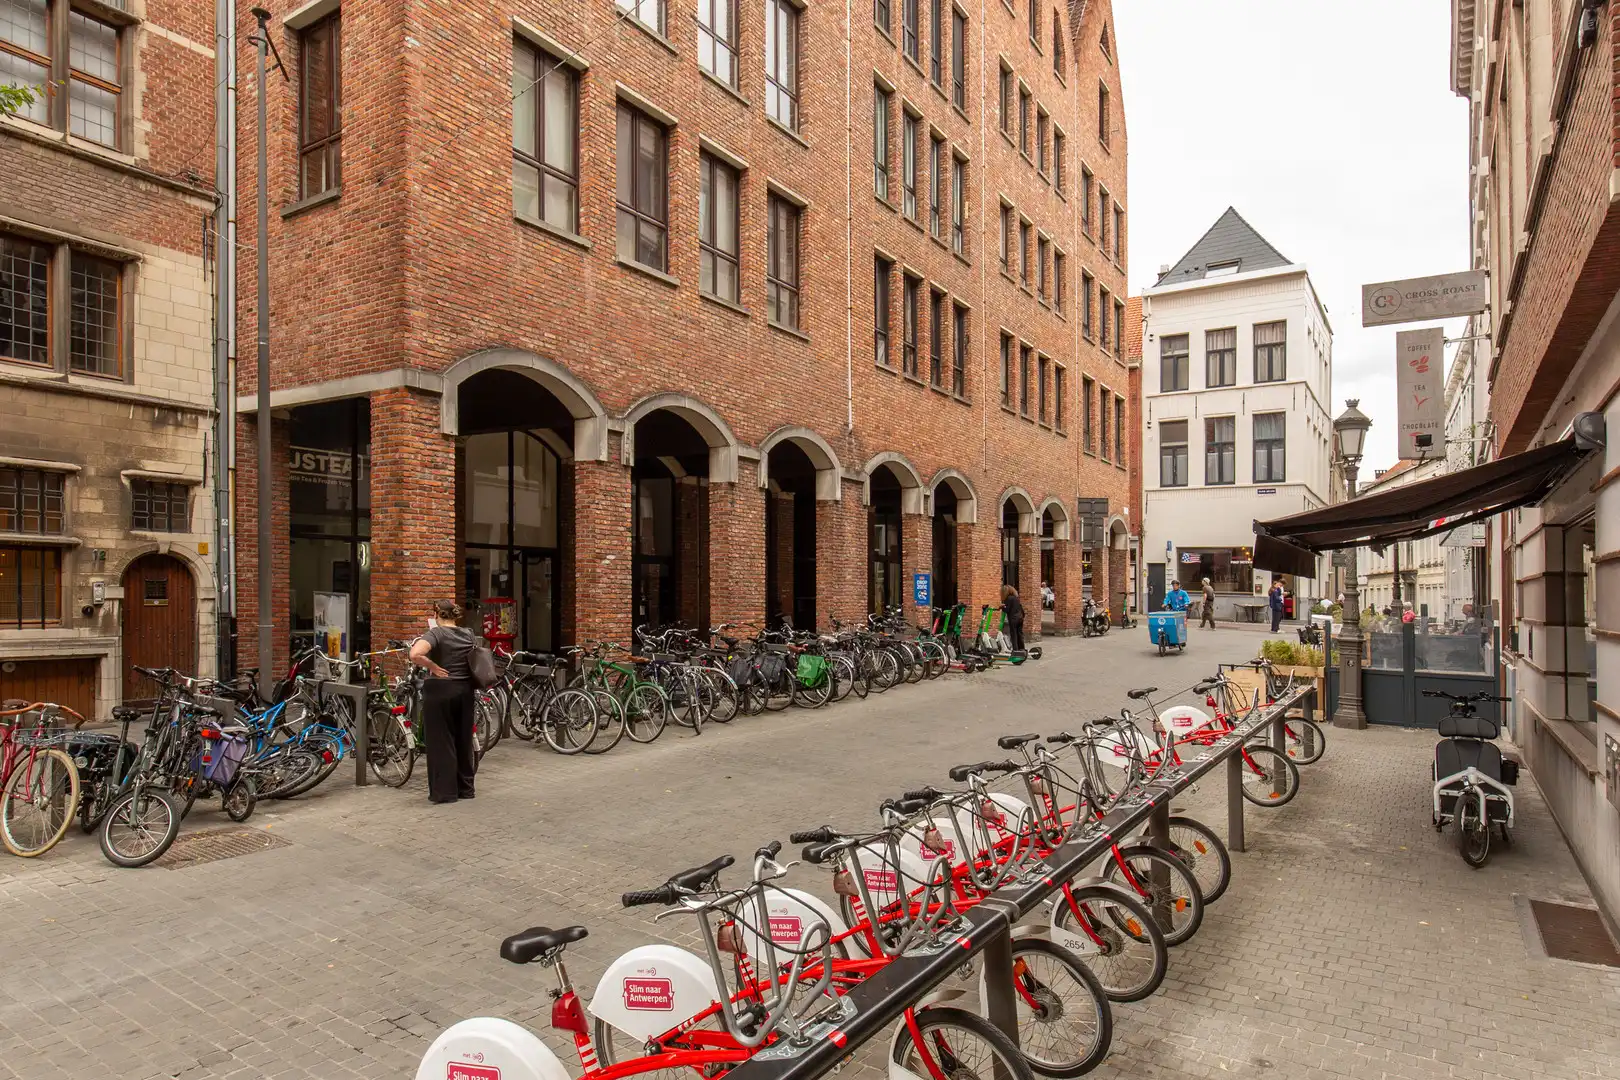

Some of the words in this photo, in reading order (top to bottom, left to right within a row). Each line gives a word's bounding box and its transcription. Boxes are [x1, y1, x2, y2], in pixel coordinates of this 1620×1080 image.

[1405, 289, 1438, 300] CROSS
[1443, 285, 1478, 295] ROAST
[1407, 344, 1431, 352] COFFEE
[1402, 422, 1439, 430] CHOCOLATE
[1064, 939, 1085, 950] 2654
[629, 984, 645, 993] Slim
[645, 986, 662, 994] naar
[630, 994, 668, 1004] Antwerpen
[453, 1070, 470, 1080] Slim
